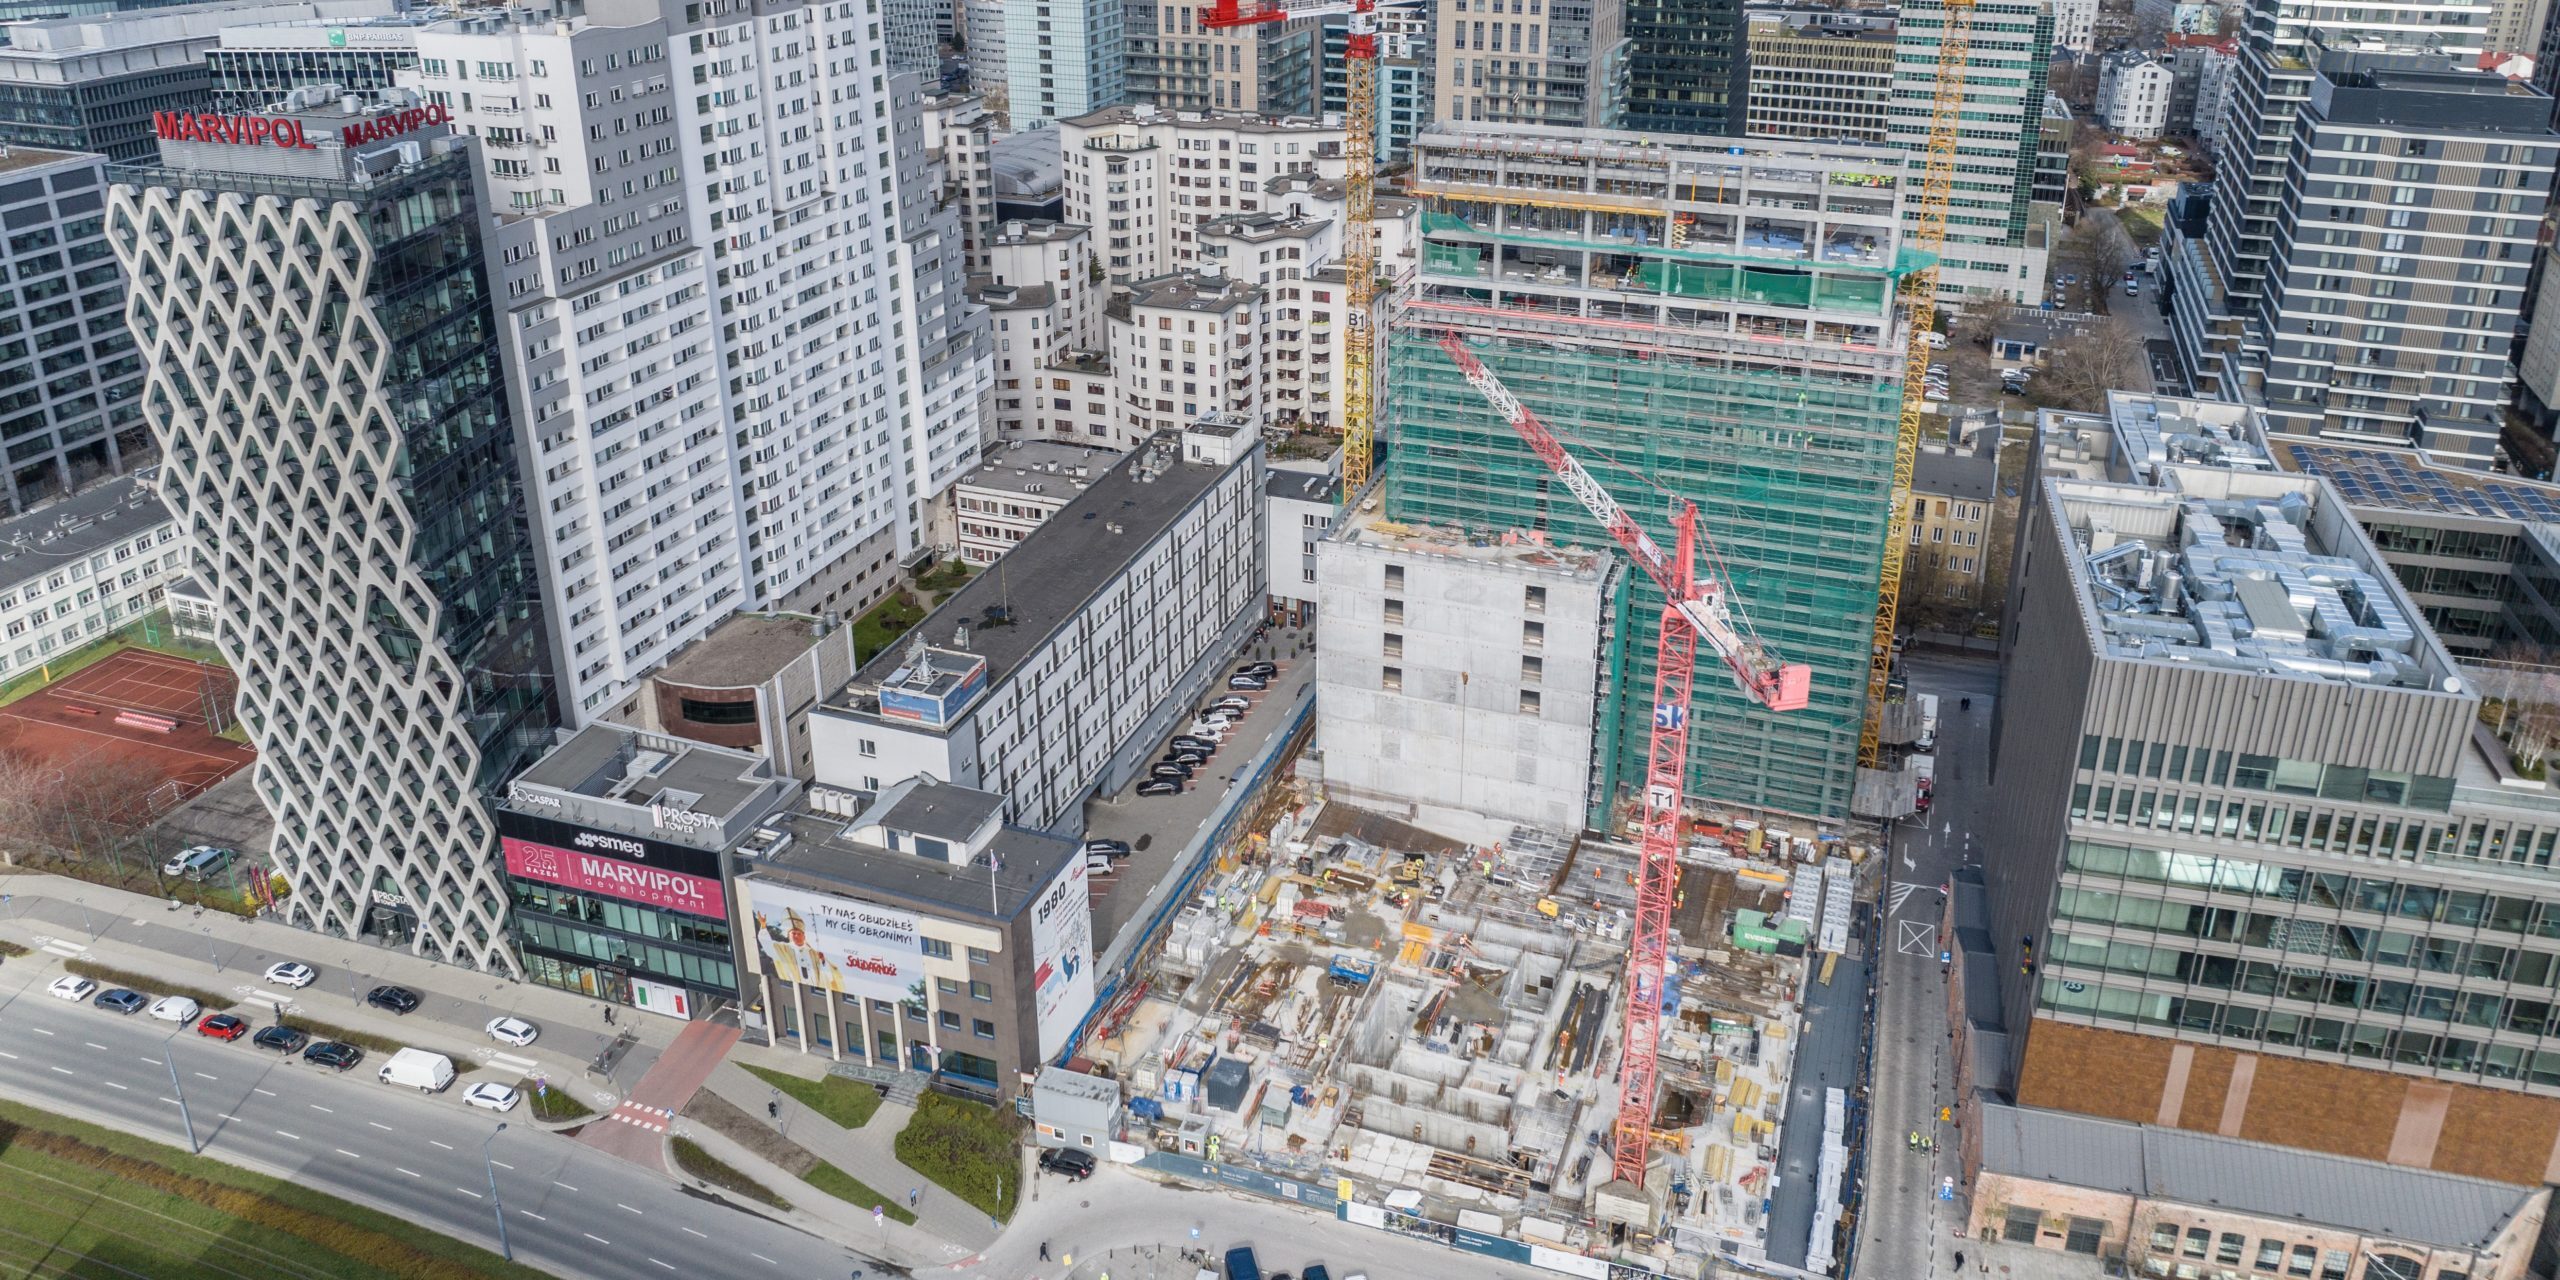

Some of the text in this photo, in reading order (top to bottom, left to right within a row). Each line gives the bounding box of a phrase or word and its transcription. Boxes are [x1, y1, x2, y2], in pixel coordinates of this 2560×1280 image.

[153, 111, 317, 149] MARVIPOL
[343, 102, 455, 148] MARVIPOL
[1349, 313, 1364, 327] B1
[528, 794, 561, 808] CASPAR
[1652, 792, 1672, 807] T1
[663, 807, 720, 830] PROSTA
[665, 821, 695, 834] TOWER
[599, 836, 645, 858] smeg
[522, 846, 557, 868] 25
[542, 861, 557, 871] LAT
[526, 866, 559, 879] RAZEM
[581, 857, 703, 899] MARVIPOL
[585, 878, 705, 909] development
[1038, 881, 1066, 924] 1980
[821, 905, 832, 915] TY
[836, 909, 856, 919] NAS
[825, 919, 838, 929] MY
